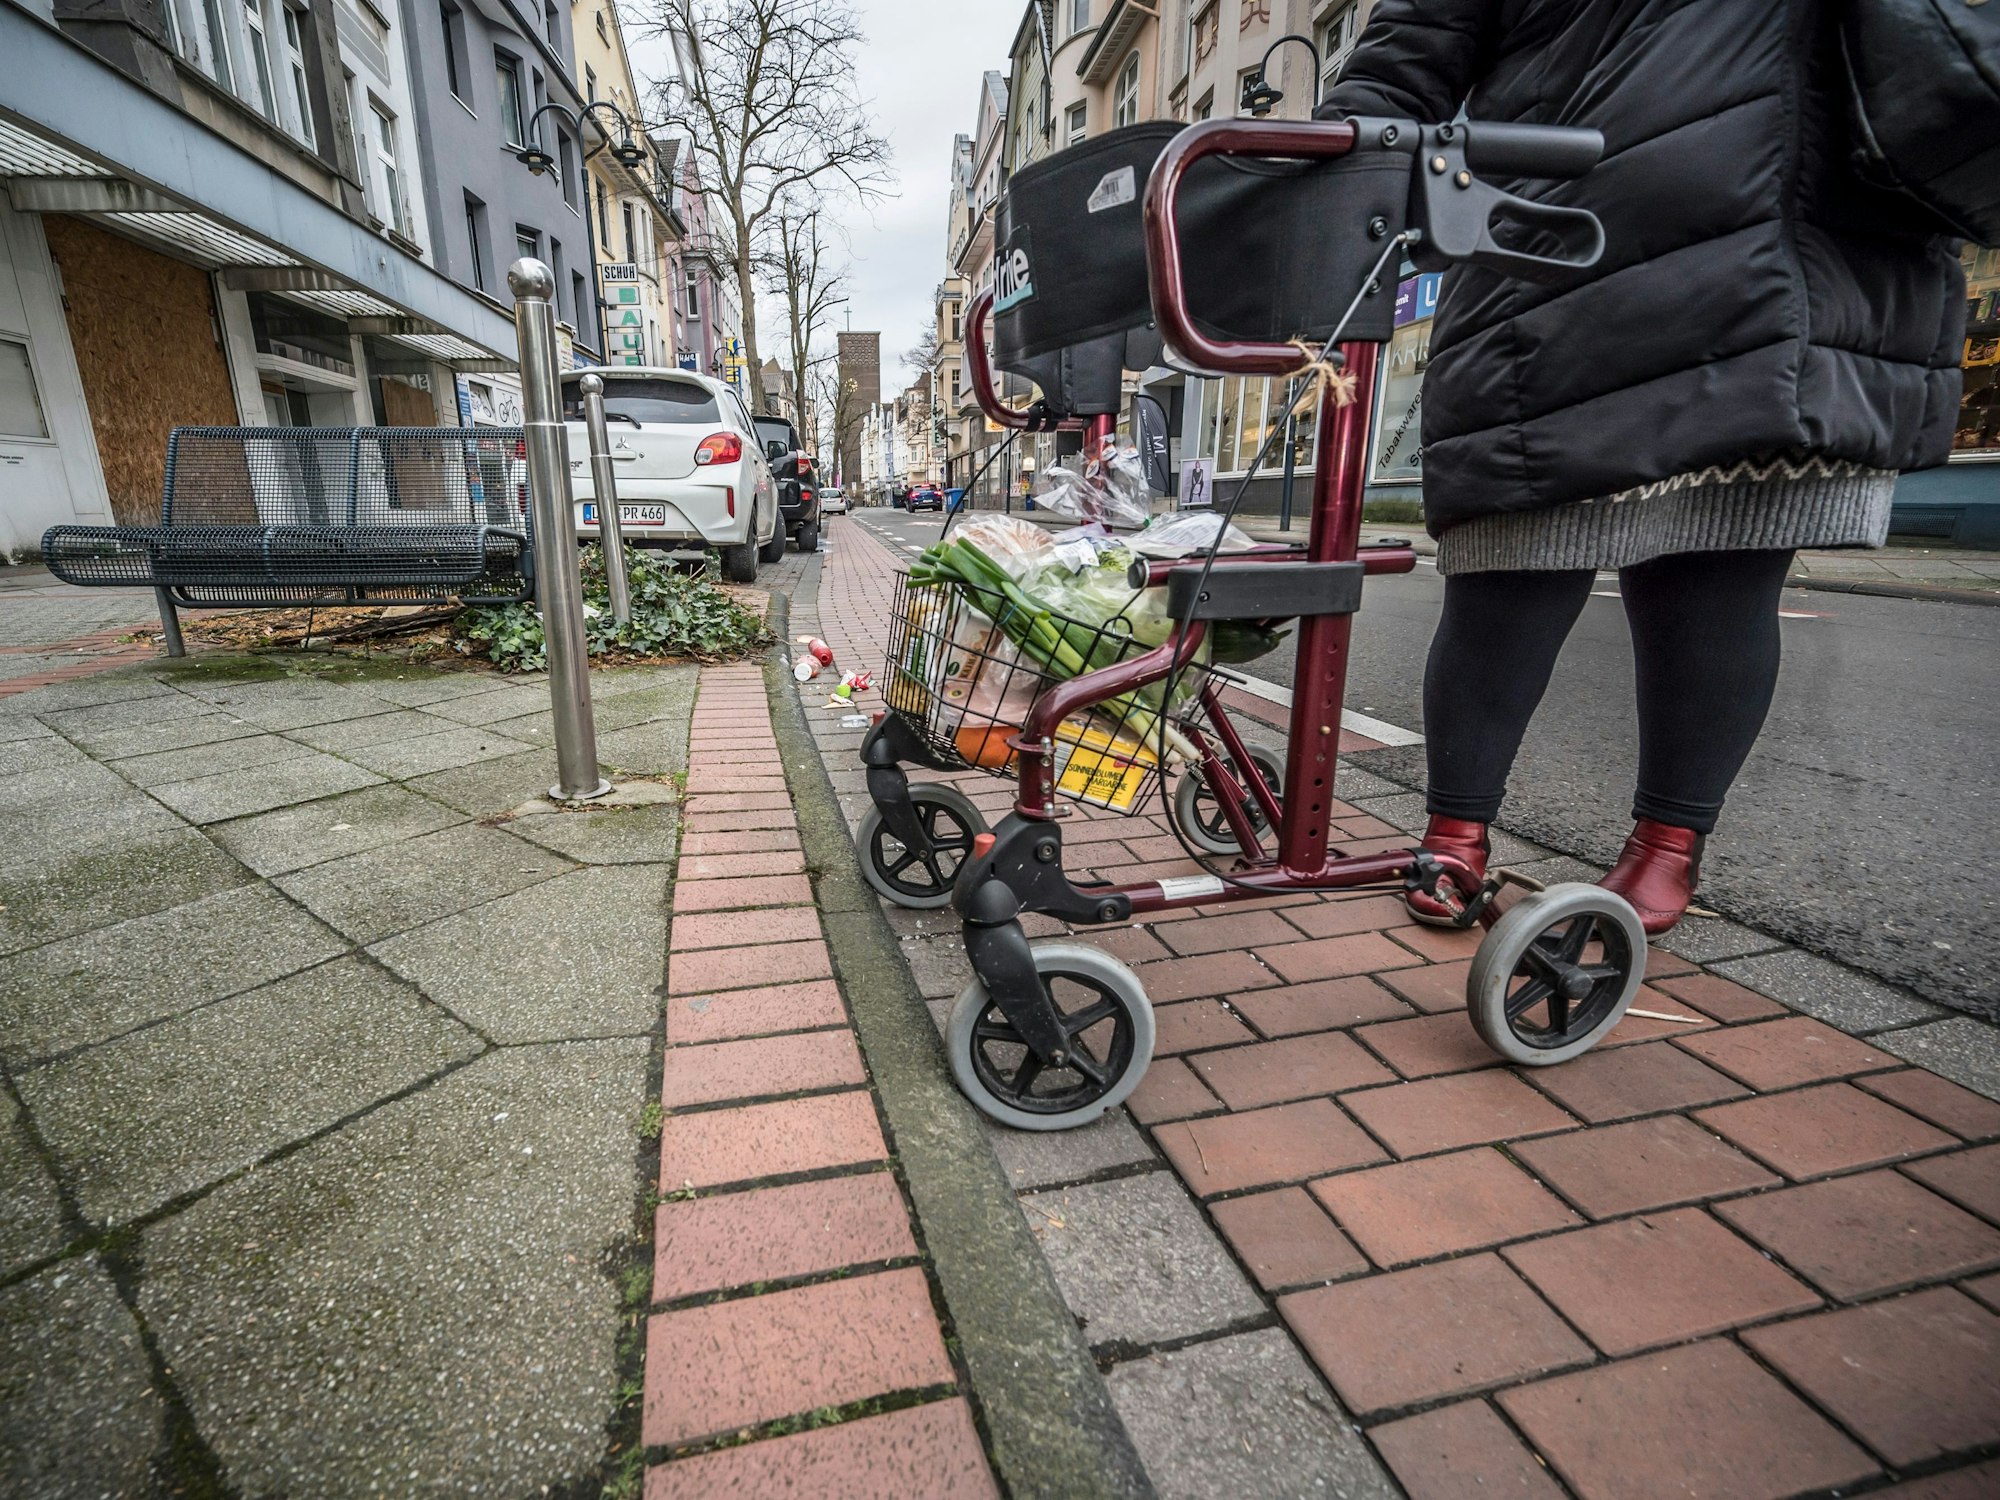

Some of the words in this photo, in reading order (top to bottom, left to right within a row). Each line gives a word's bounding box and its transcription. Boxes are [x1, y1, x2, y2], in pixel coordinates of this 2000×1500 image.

[604, 265, 635, 279] SCHUH
[993, 248, 1030, 300] drive
[623, 506, 638, 519] PR
[641, 506, 663, 519] 466
